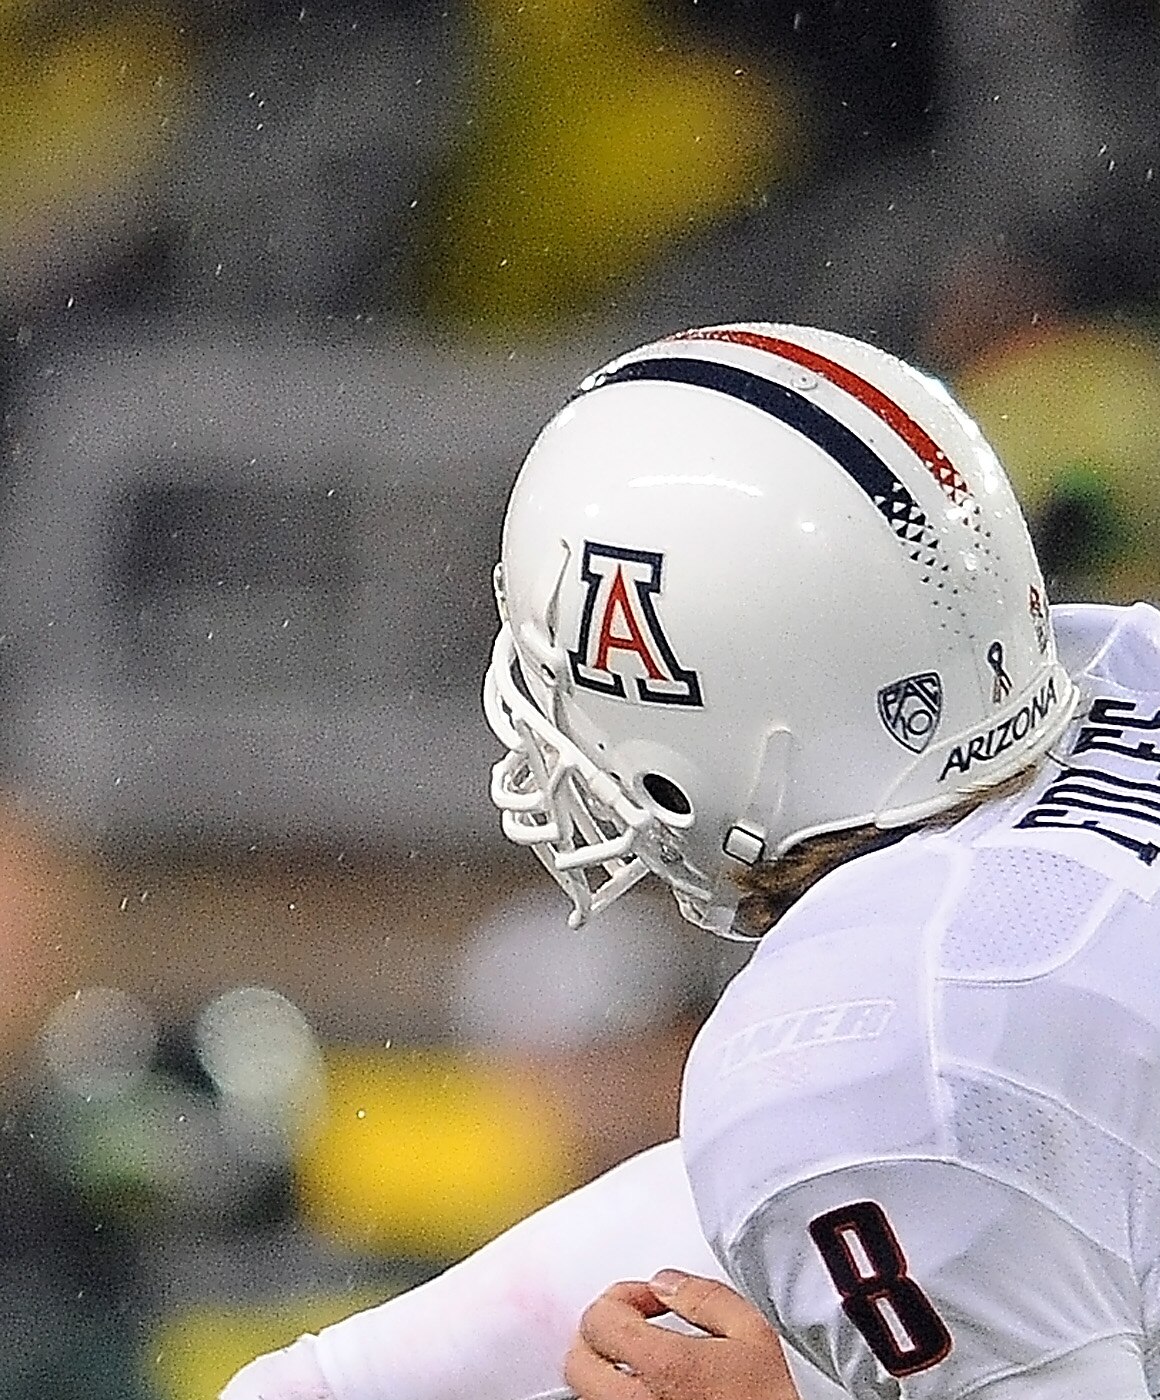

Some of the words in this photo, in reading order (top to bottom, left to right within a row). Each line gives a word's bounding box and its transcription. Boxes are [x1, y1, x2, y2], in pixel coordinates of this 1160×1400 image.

[567, 540, 704, 707] A
[882, 677, 941, 729] PAC
[899, 708, 929, 741] 10
[937, 676, 1057, 782] ARIZONA
[809, 1200, 954, 1378] 8
